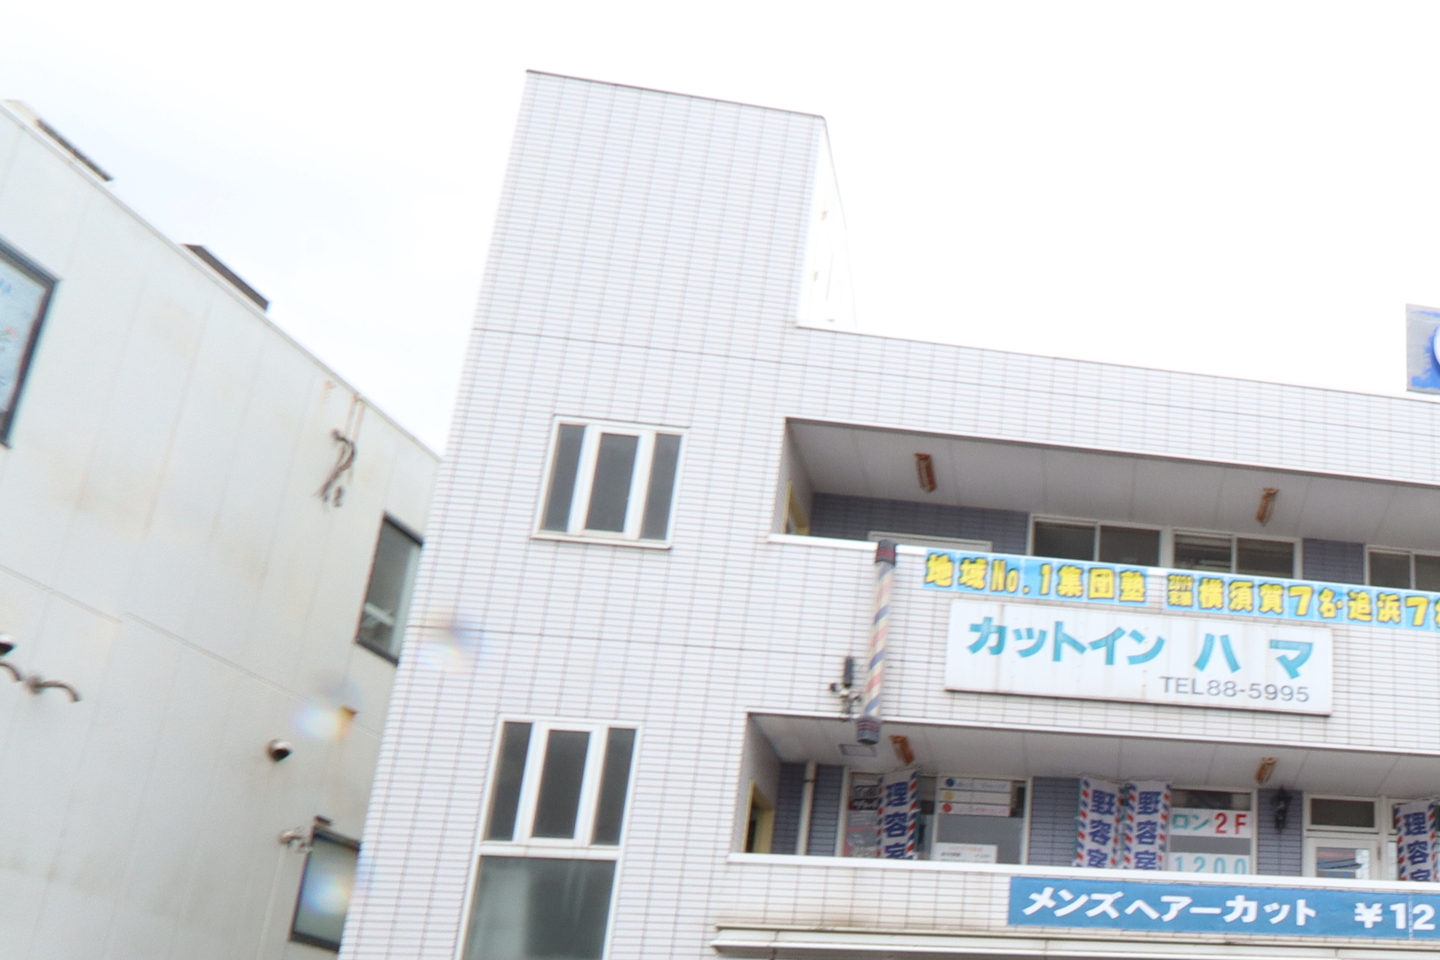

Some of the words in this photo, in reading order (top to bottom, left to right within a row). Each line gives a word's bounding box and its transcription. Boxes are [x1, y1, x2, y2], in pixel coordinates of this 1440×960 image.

[967, 616, 1166, 666] カットイン
[1160, 675, 1310, 703] TEL88-5995
[1022, 885, 1318, 927] メンズヘアーカット
